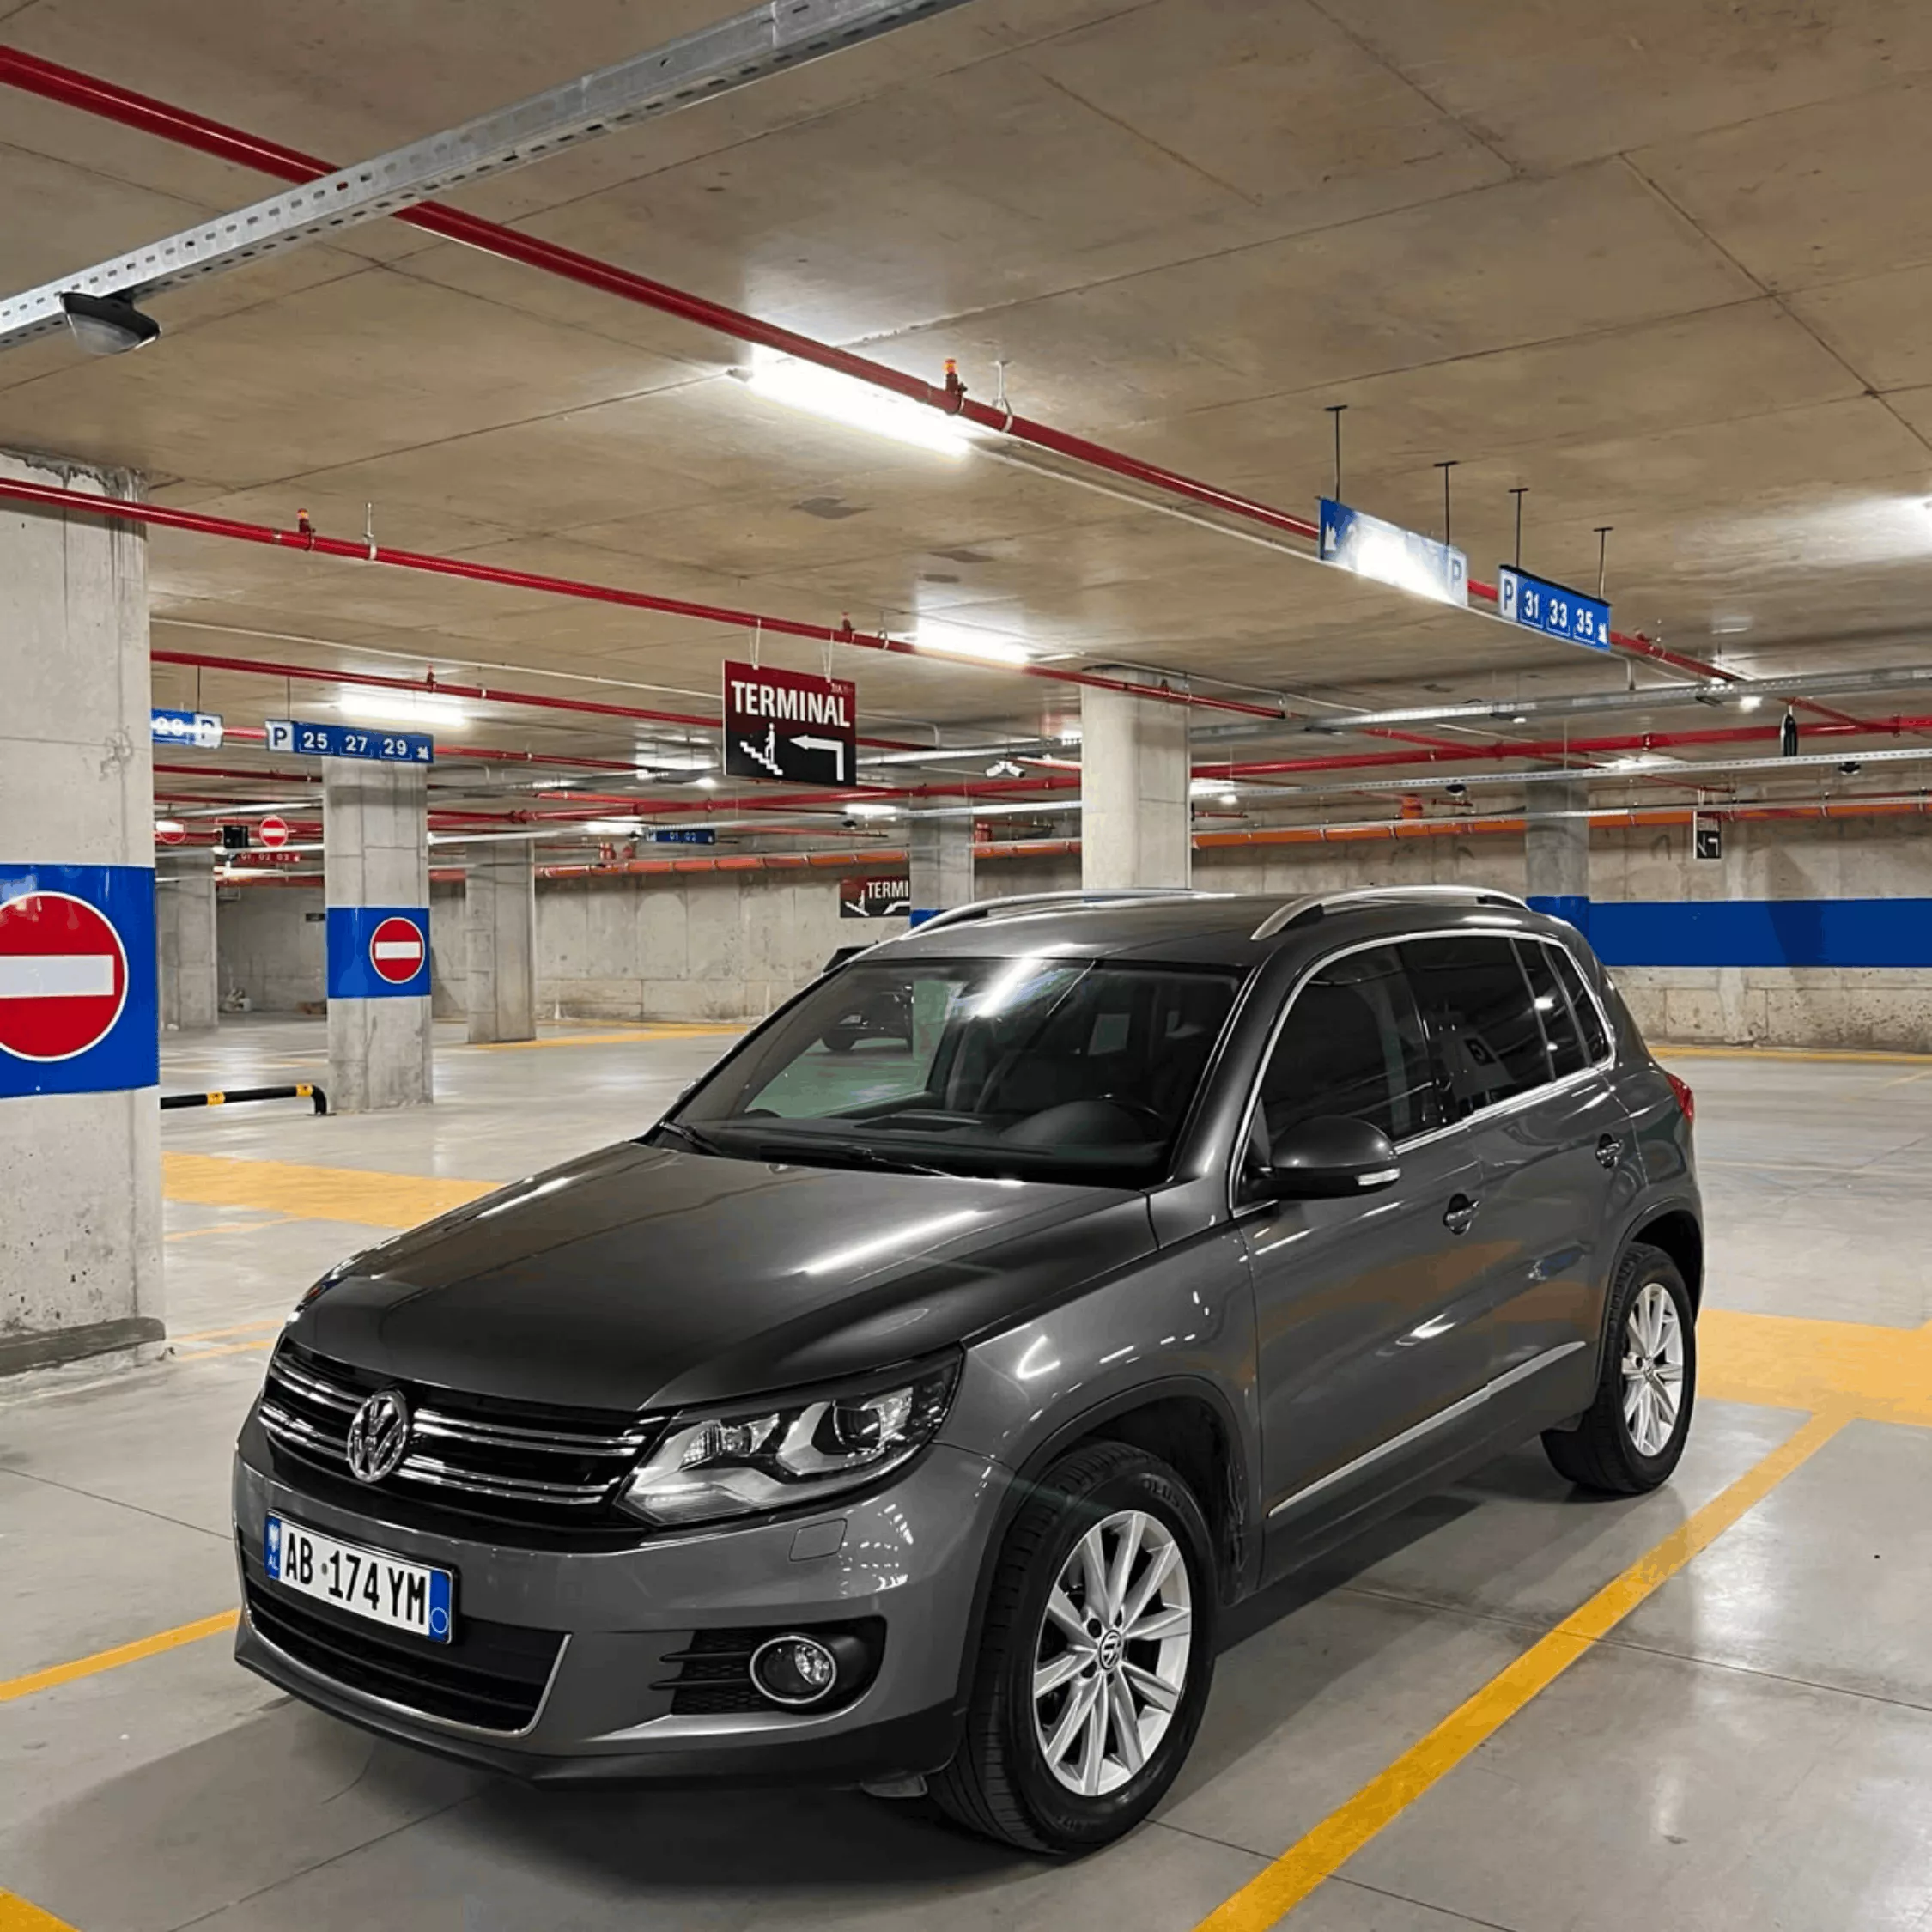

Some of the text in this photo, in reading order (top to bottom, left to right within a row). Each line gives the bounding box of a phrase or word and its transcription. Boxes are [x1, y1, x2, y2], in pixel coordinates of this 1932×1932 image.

[1451, 559, 1463, 592] P
[1503, 576, 1593, 634] P 31 33 35
[731, 680, 850, 727] TERMINAL
[273, 727, 407, 756] P 25 27 29
[866, 880, 908, 899] TERMI
[285, 1532, 426, 1625] AB 174 YM
